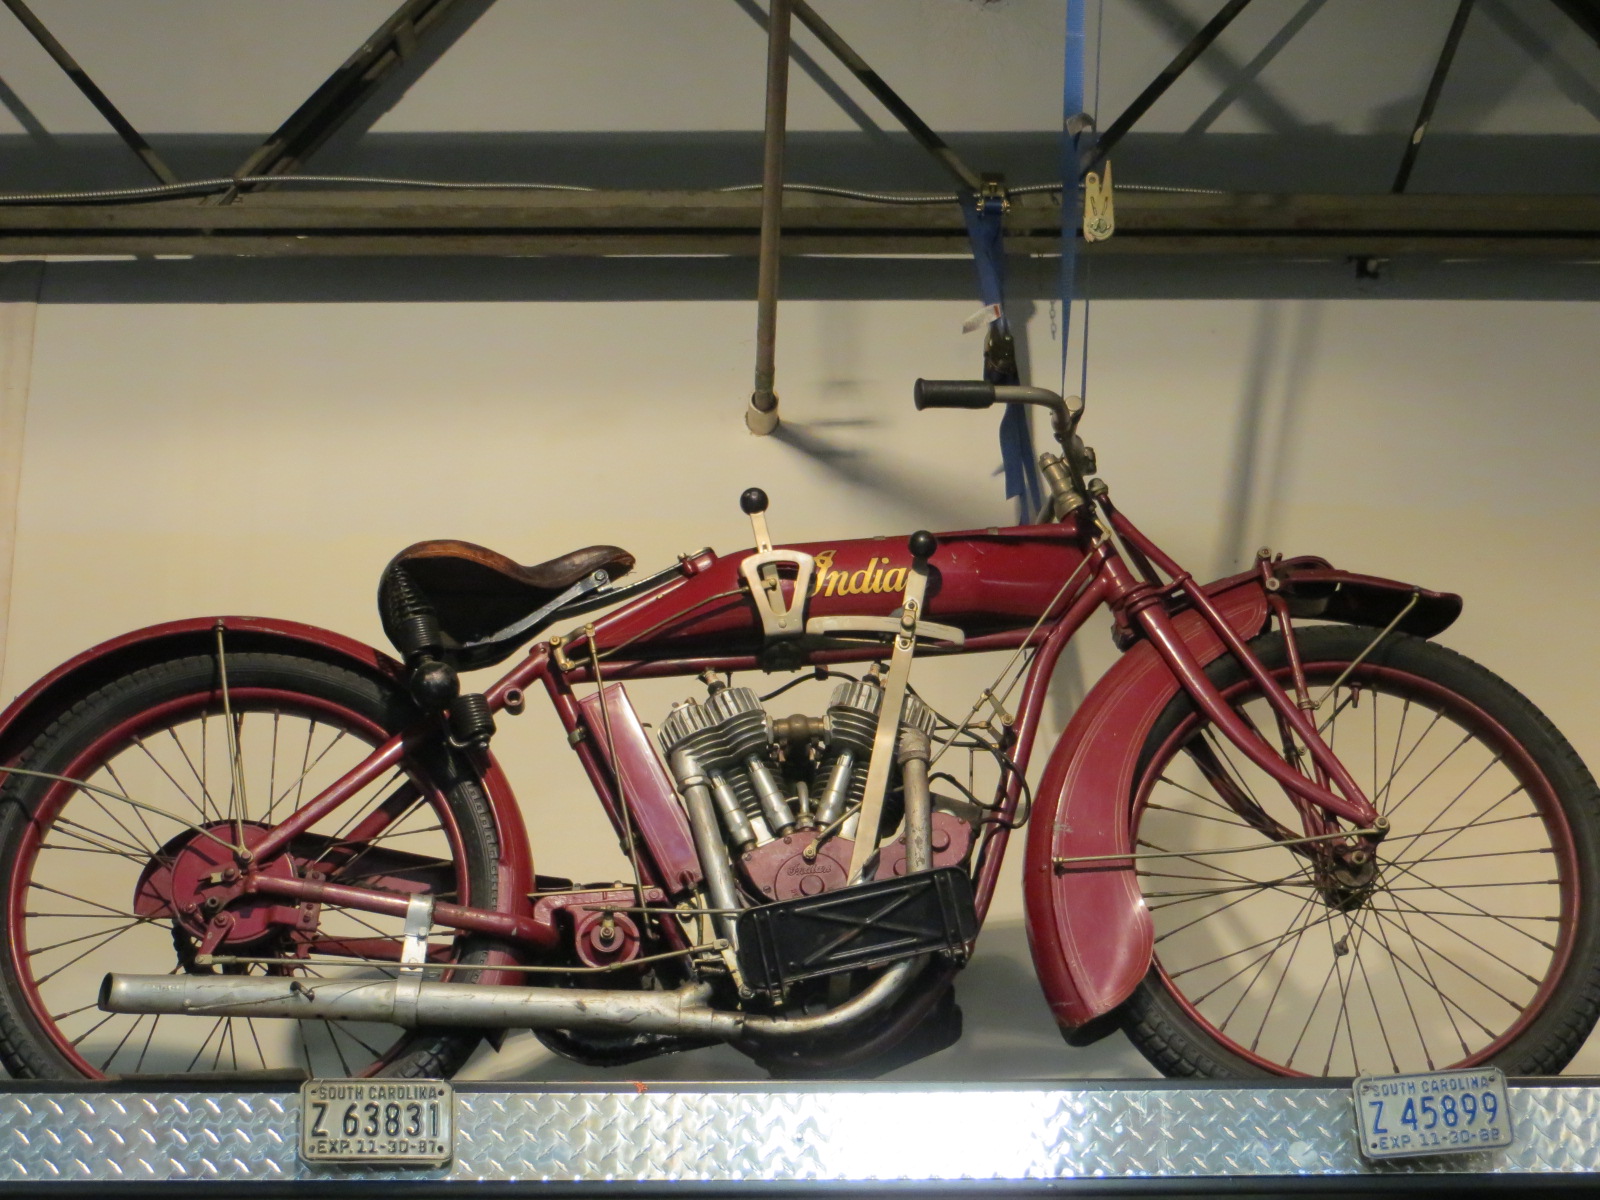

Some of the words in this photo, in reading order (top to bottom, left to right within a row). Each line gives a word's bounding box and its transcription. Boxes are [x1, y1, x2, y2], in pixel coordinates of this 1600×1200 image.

[806, 550, 907, 597] India
[319, 1086, 363, 1100] SOUTH
[1373, 1082, 1415, 1097] SOUTH
[1421, 1076, 1489, 1093] CAROLINA
[311, 1102, 328, 1137] Z
[343, 1101, 439, 1137] 63831
[1369, 1100, 1388, 1134] Z
[1401, 1091, 1498, 1131] 45899
